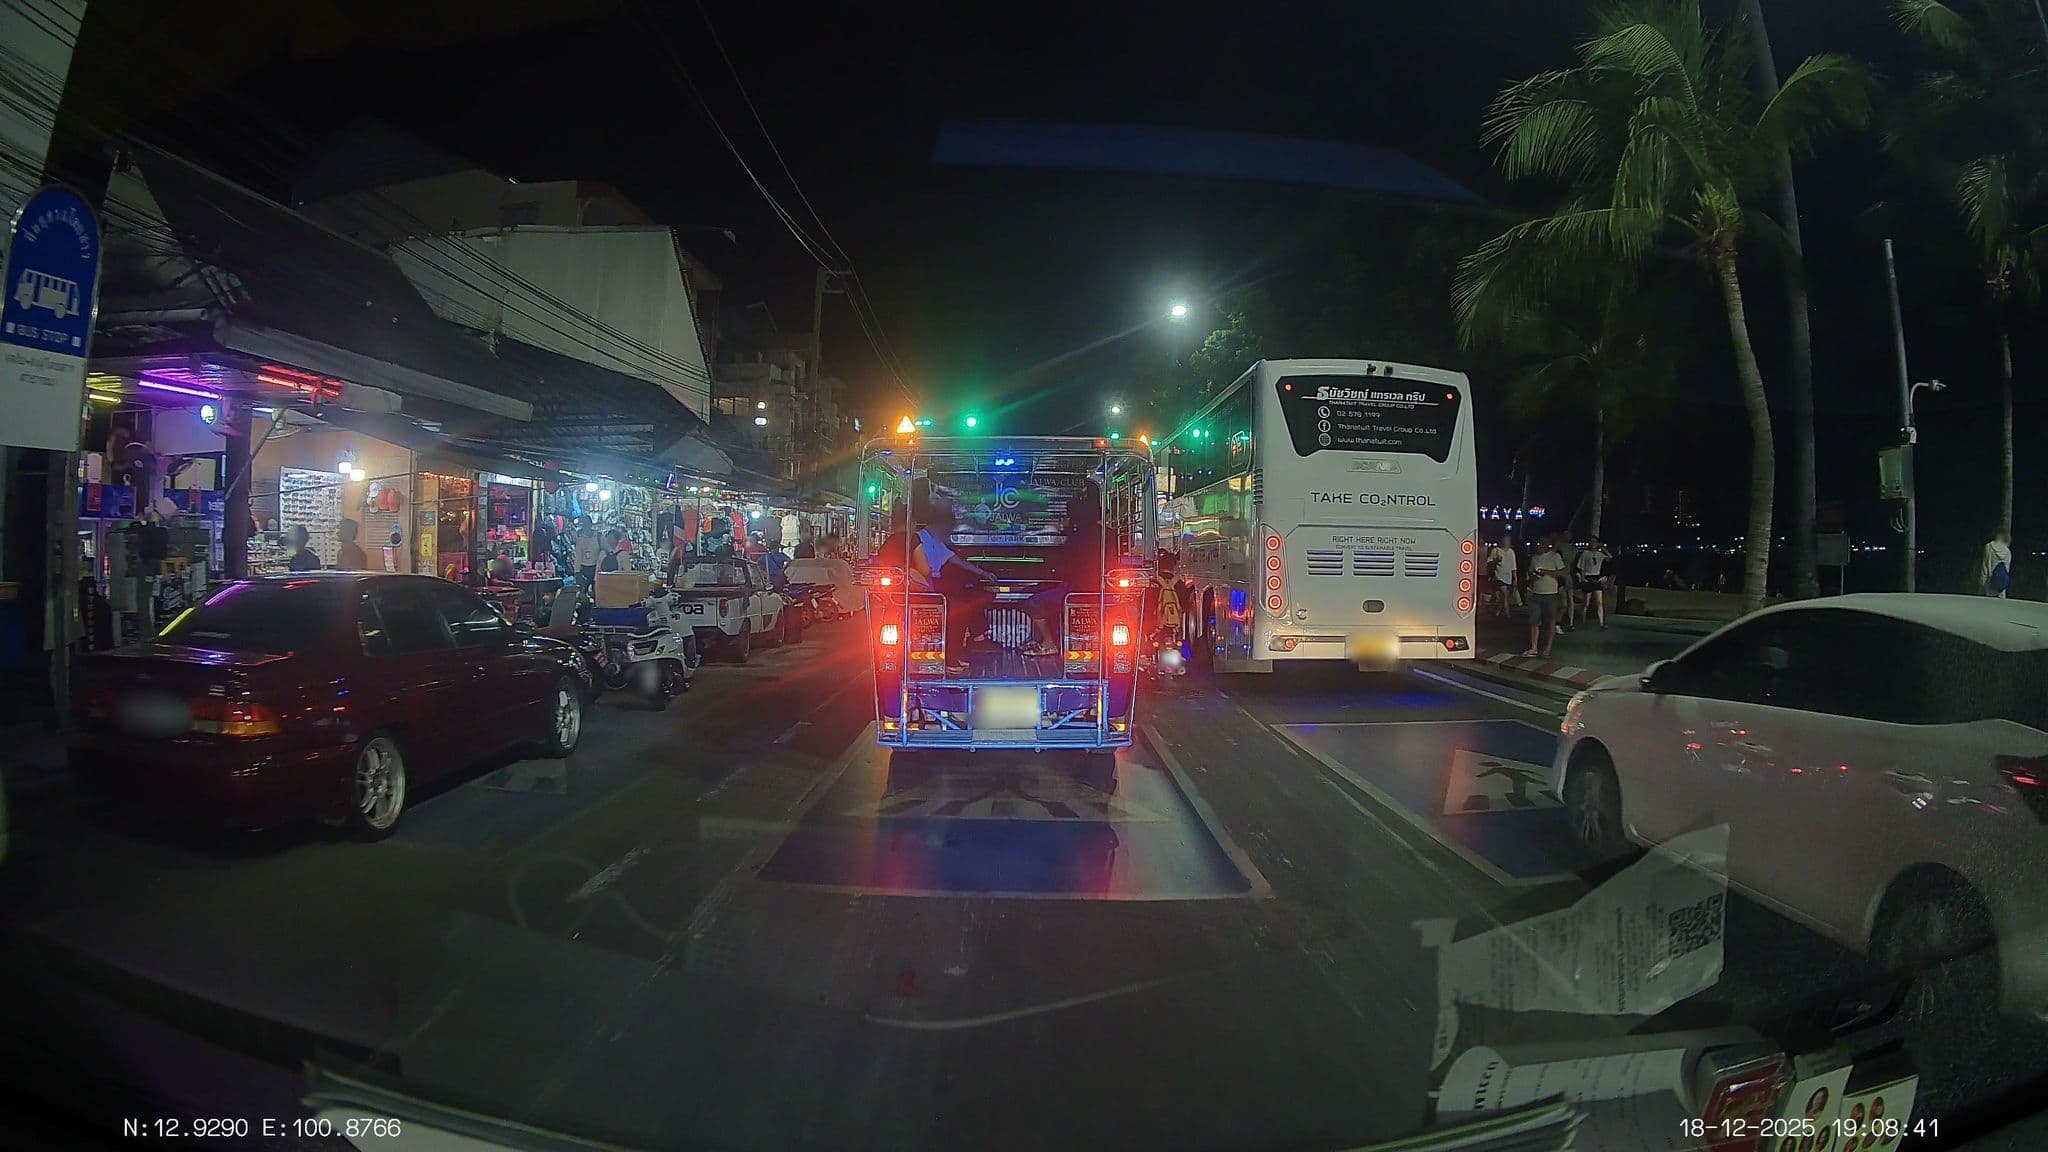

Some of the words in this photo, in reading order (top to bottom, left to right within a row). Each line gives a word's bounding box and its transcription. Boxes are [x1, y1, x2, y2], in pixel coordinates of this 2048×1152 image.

[16, 324, 40, 339] BUS
[40, 329, 70, 344] STOP
[1370, 391, 1403, 401] แทรเวล
[1393, 426, 1413, 434] Group
[1310, 492, 1353, 504] TAKE
[1332, 535, 1353, 543] RIGHT
[1356, 536, 1375, 544] HERE
[1400, 537, 1416, 545] NOW
[1072, 617, 1097, 625] JALWA
